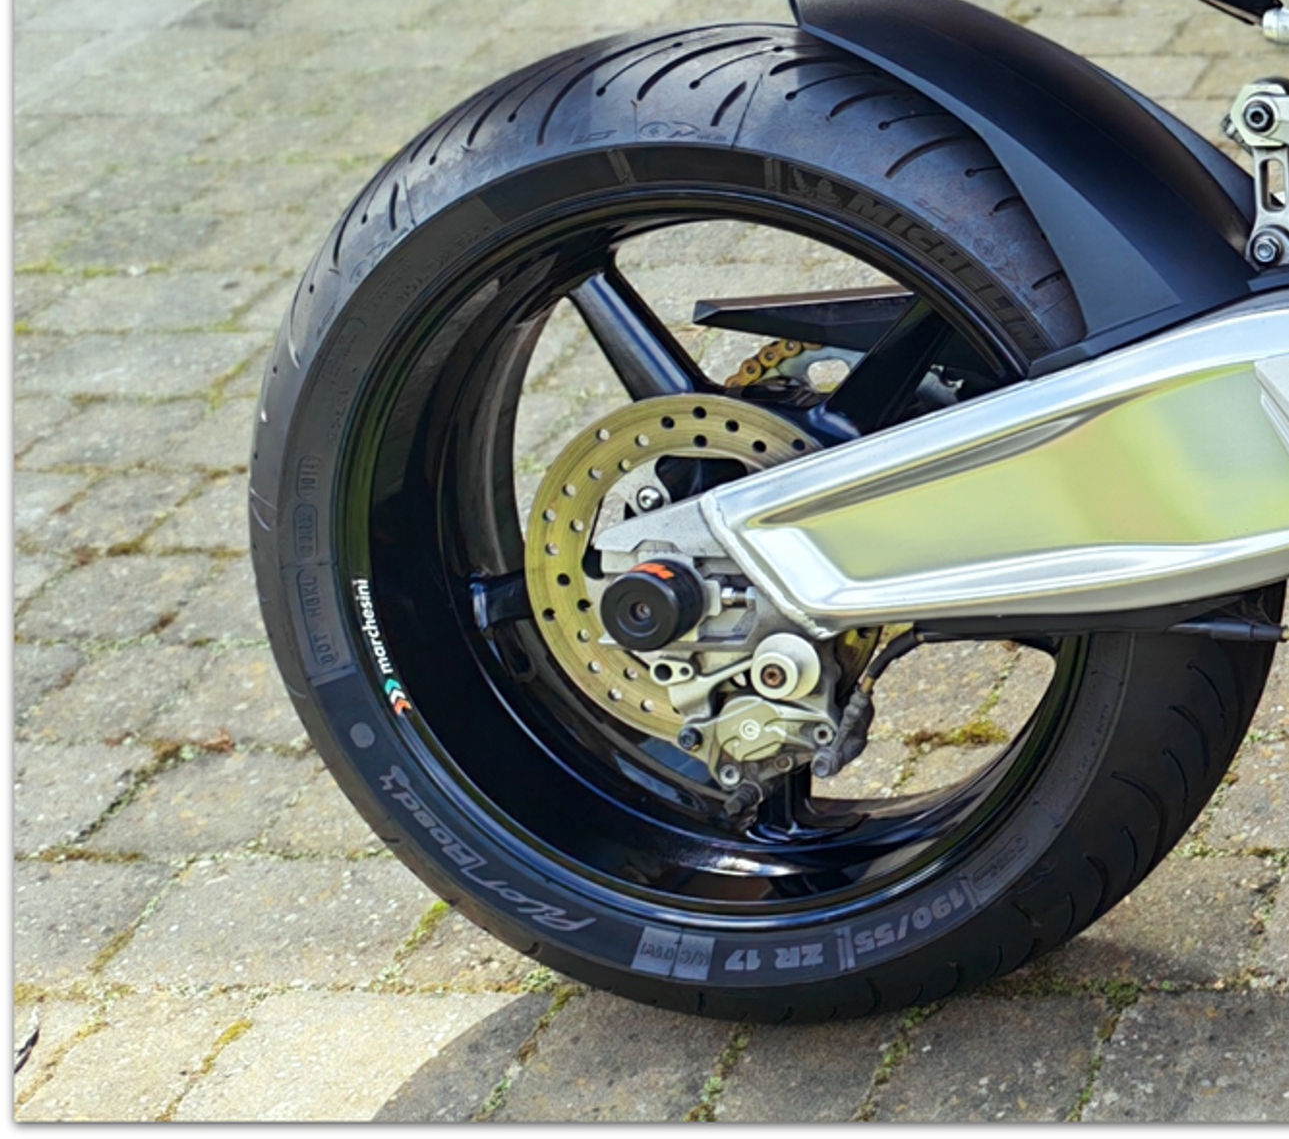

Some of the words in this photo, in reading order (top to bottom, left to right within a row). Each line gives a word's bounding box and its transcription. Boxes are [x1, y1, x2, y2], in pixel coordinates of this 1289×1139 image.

[352, 577, 394, 675] marchesini
[853, 888, 967, 956] 190/55
[723, 949, 762, 972] 17
[774, 942, 824, 970] ZR
